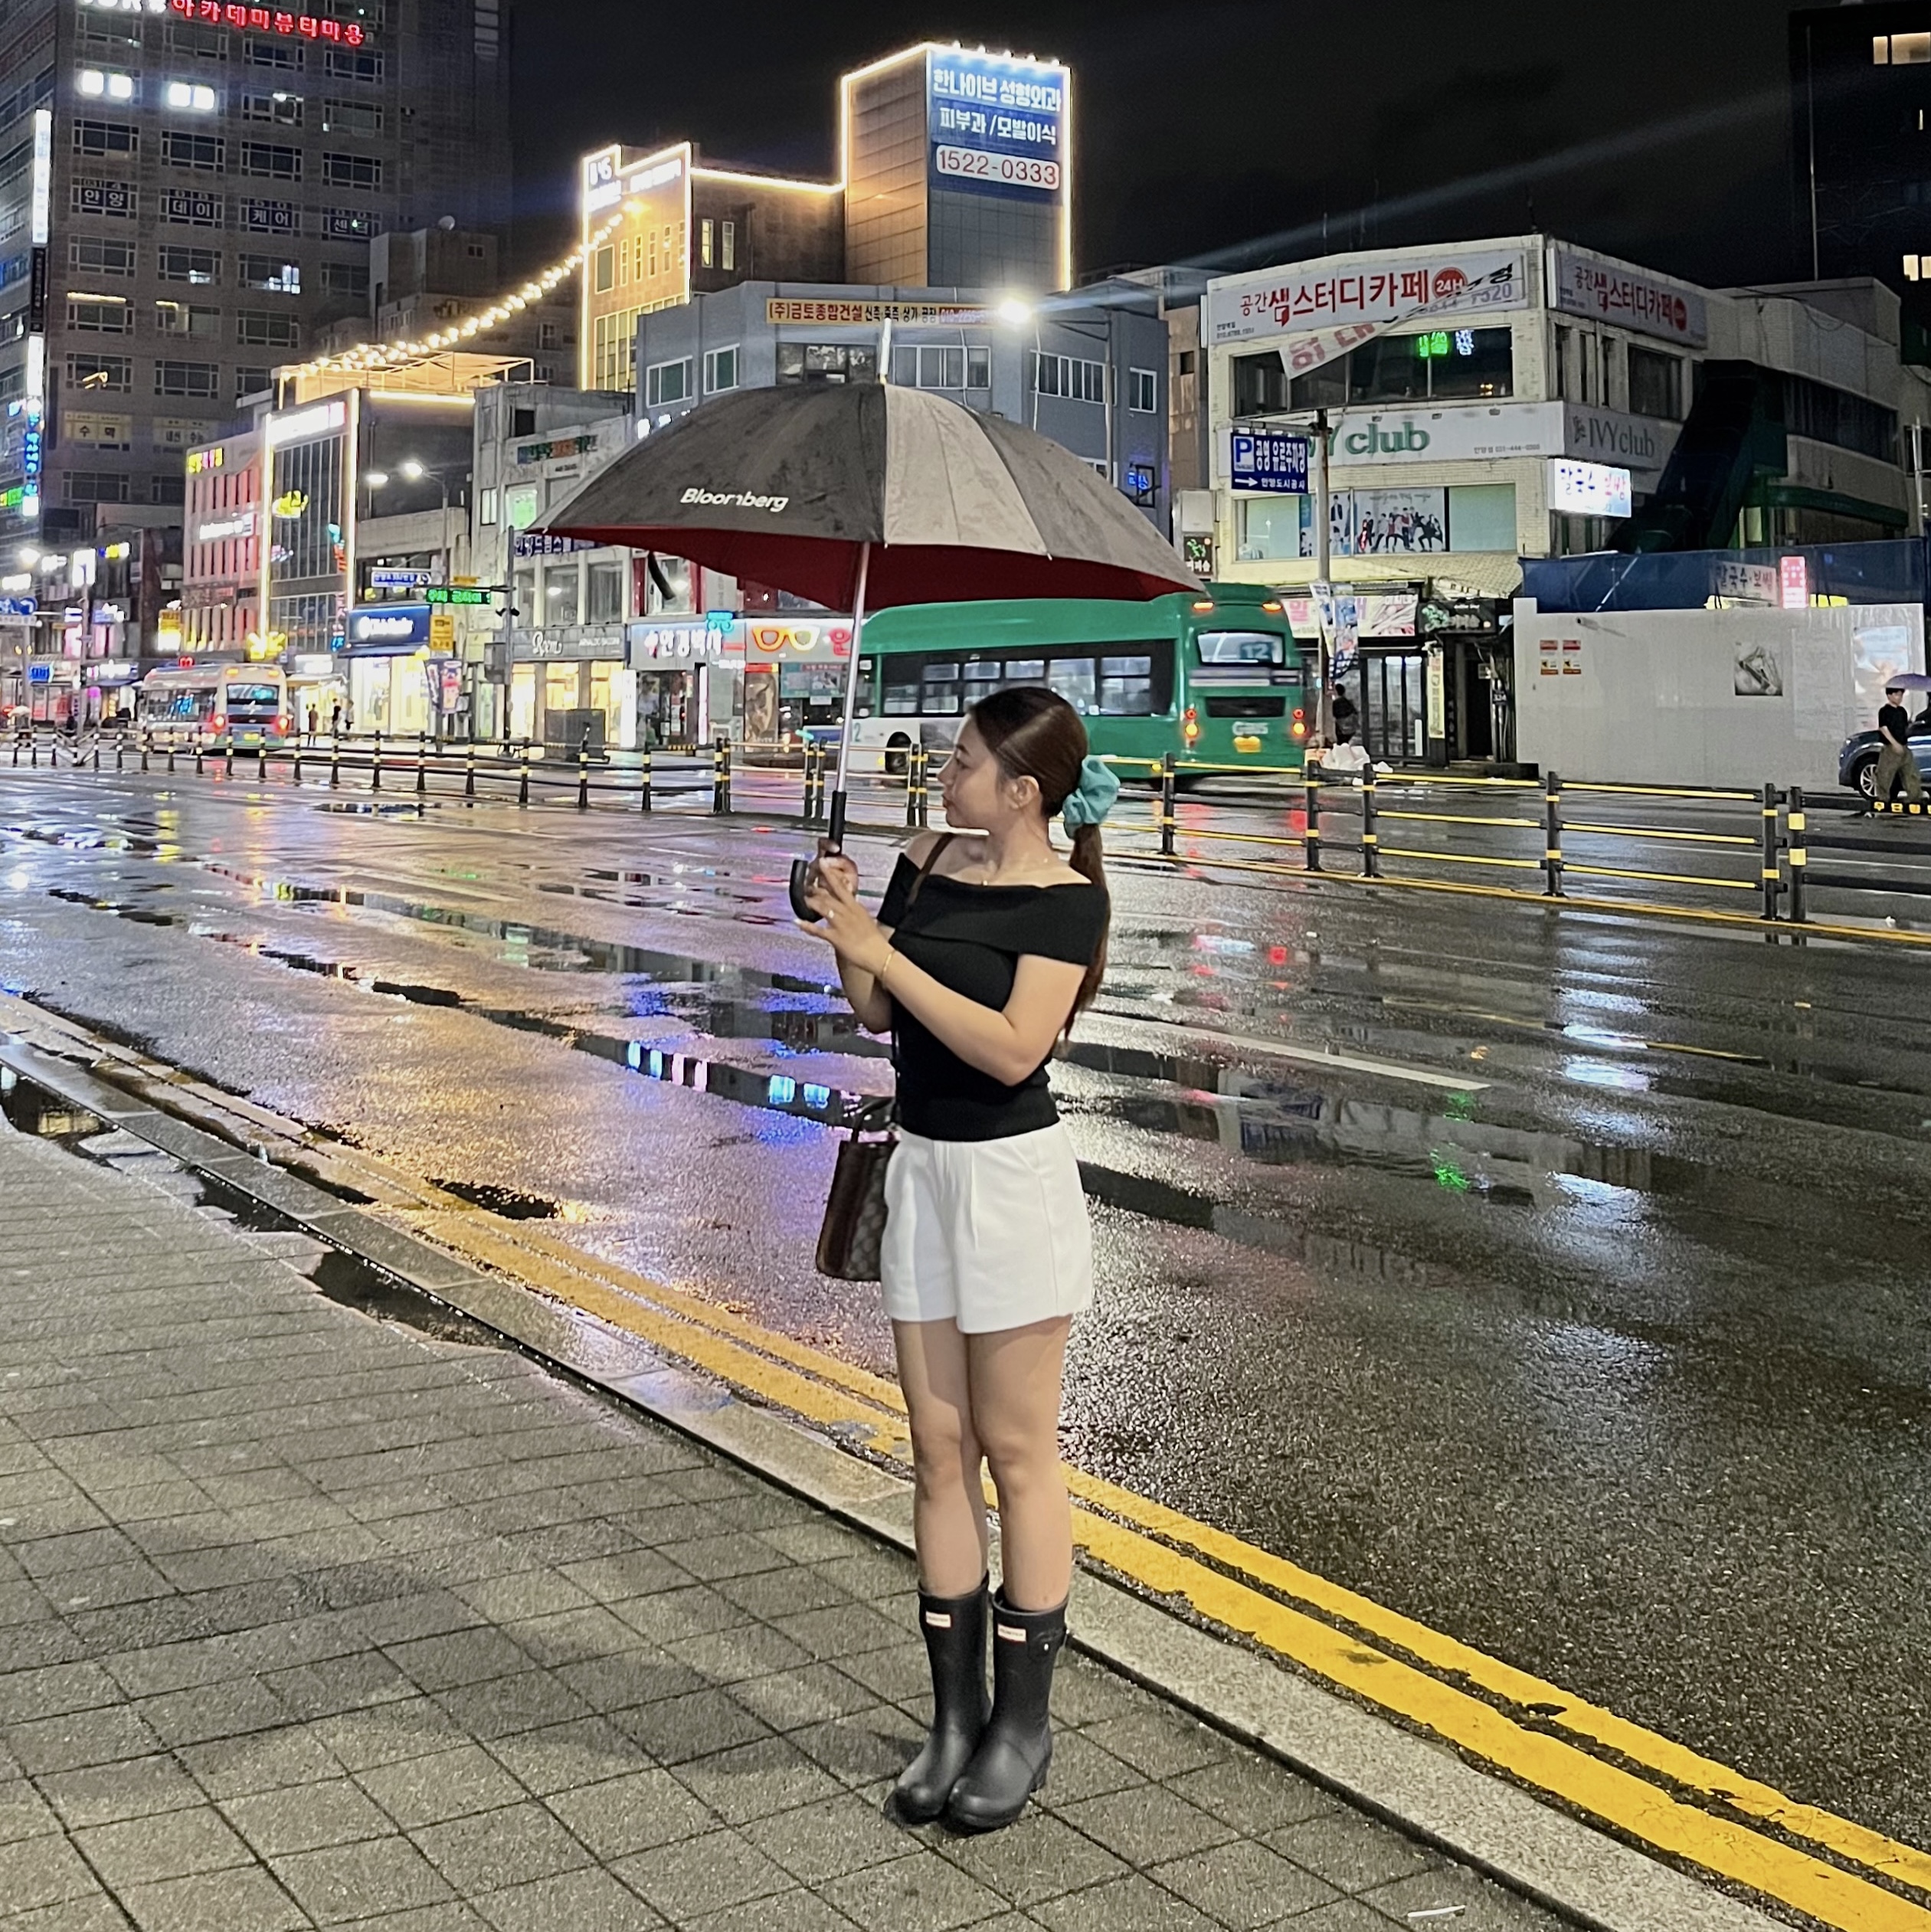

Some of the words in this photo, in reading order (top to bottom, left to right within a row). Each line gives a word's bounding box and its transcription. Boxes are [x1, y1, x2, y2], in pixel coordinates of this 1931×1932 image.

[934, 69, 997, 101] 한나이브
[1000, 80, 1062, 112] 성형외과
[940, 107, 986, 133] 피부과
[939, 150, 1056, 185] 1522-0333
[679, 487, 790, 512] Bloomberg
[1242, 643, 1269, 660] 12
